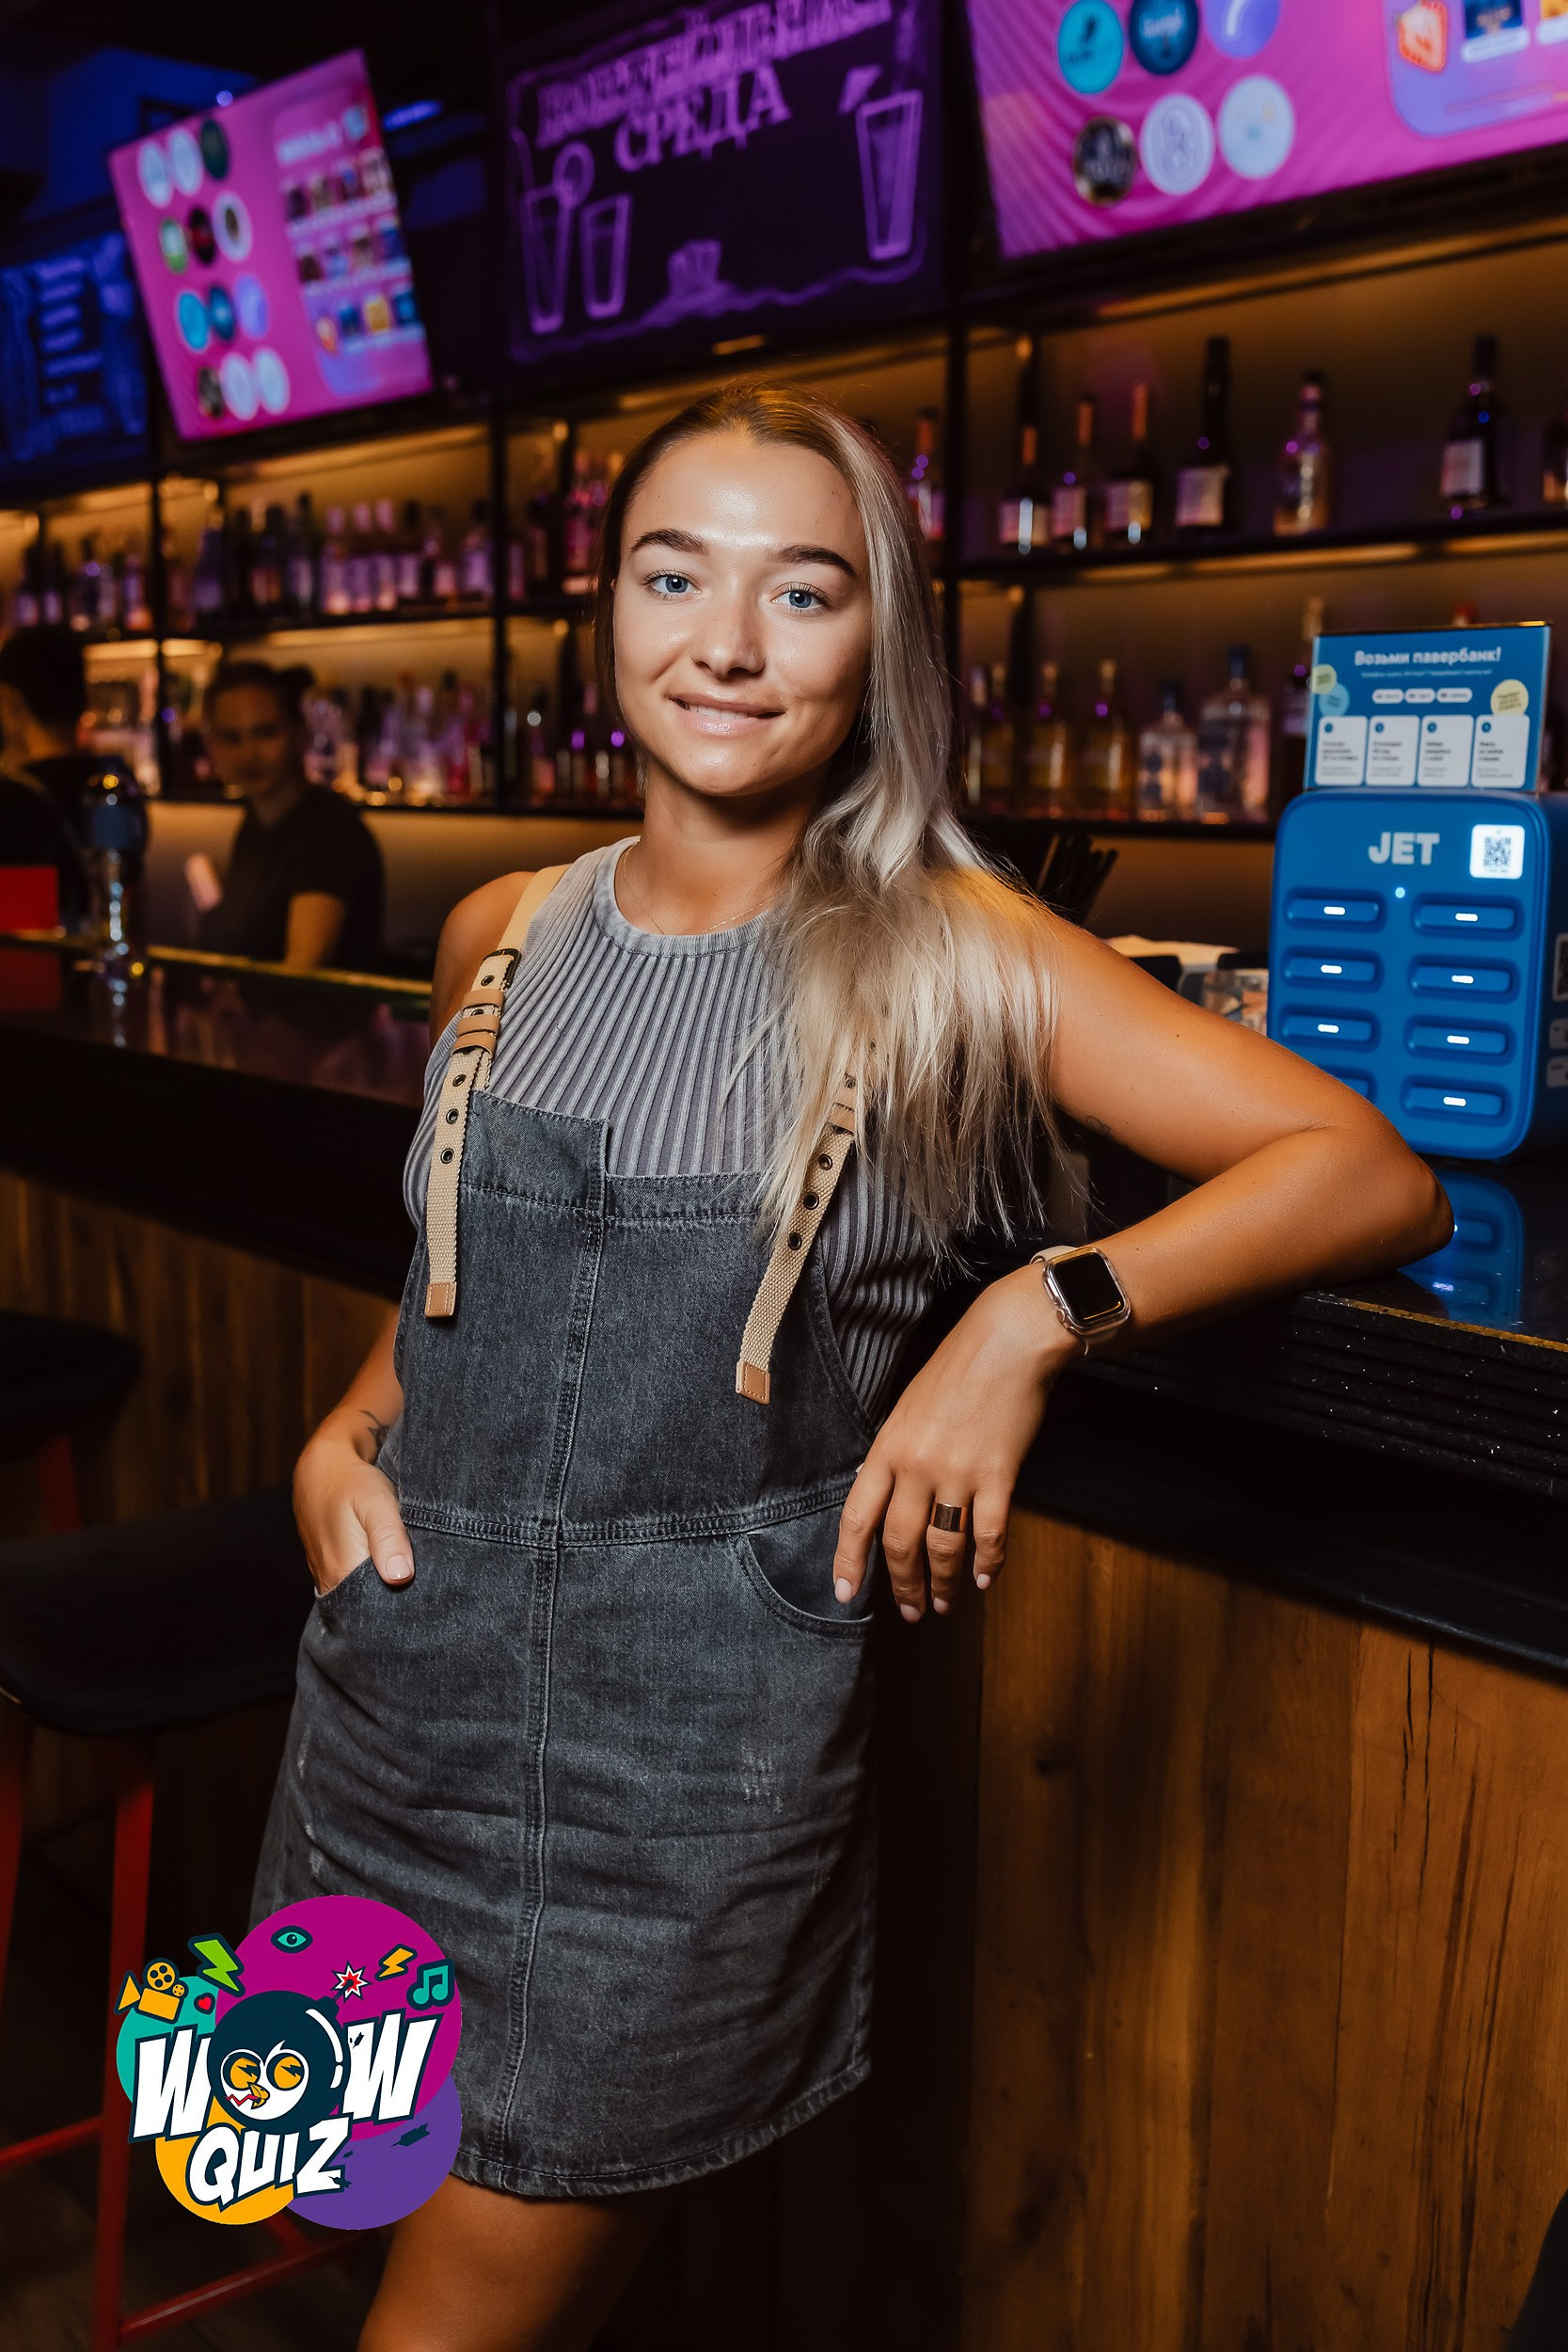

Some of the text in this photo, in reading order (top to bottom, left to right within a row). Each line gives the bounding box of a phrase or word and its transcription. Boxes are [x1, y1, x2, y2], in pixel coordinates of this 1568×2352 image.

[1354, 646, 1501, 666] Возьми павербанк!
[1368, 832, 1440, 866] JET
